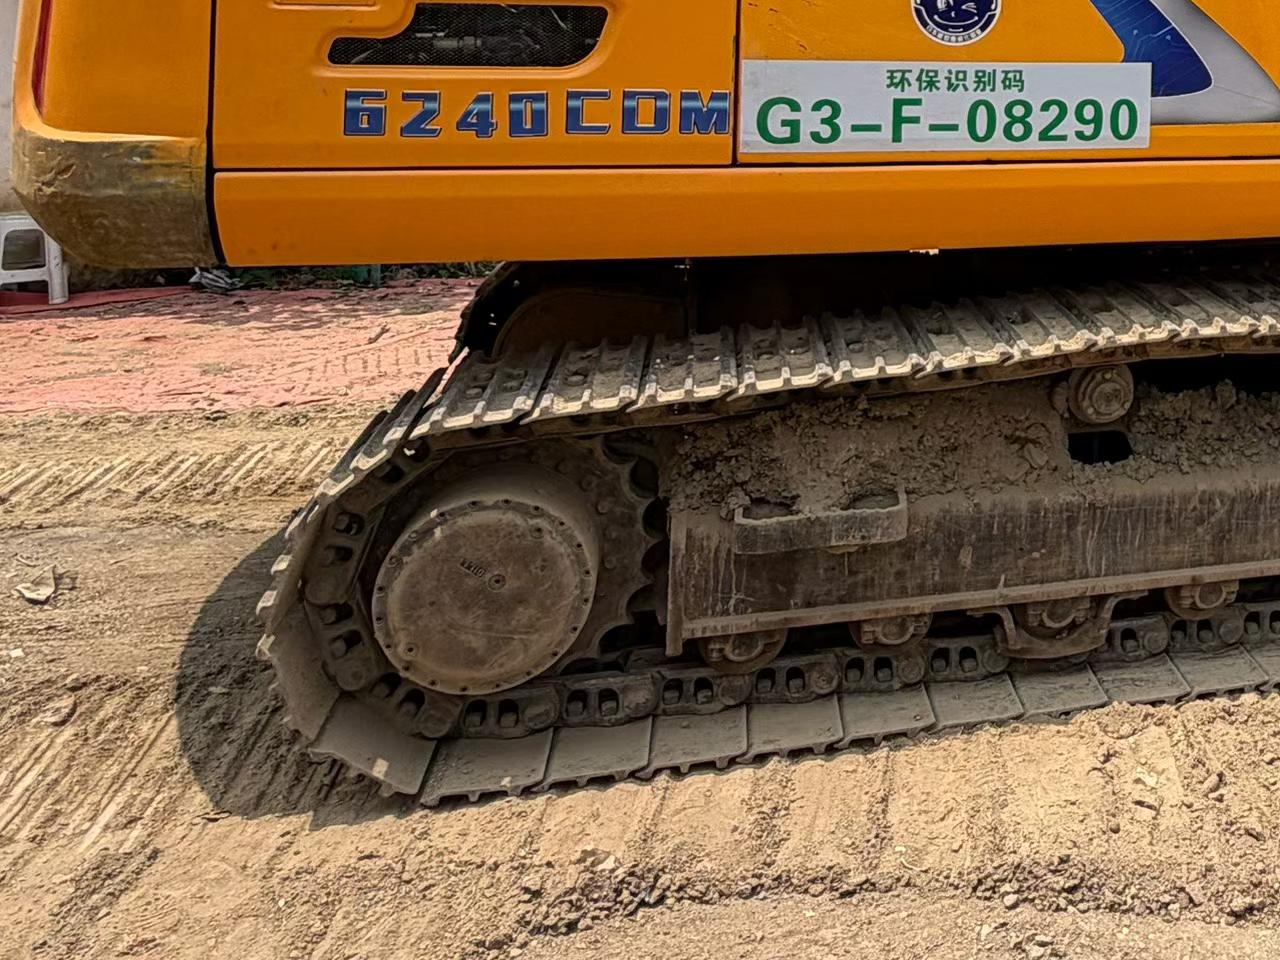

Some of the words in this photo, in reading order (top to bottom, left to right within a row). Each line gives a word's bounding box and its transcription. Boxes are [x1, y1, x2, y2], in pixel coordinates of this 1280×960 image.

[886, 68, 1025, 93] 环保识别码
[755, 96, 1139, 145] G3-F-08290
